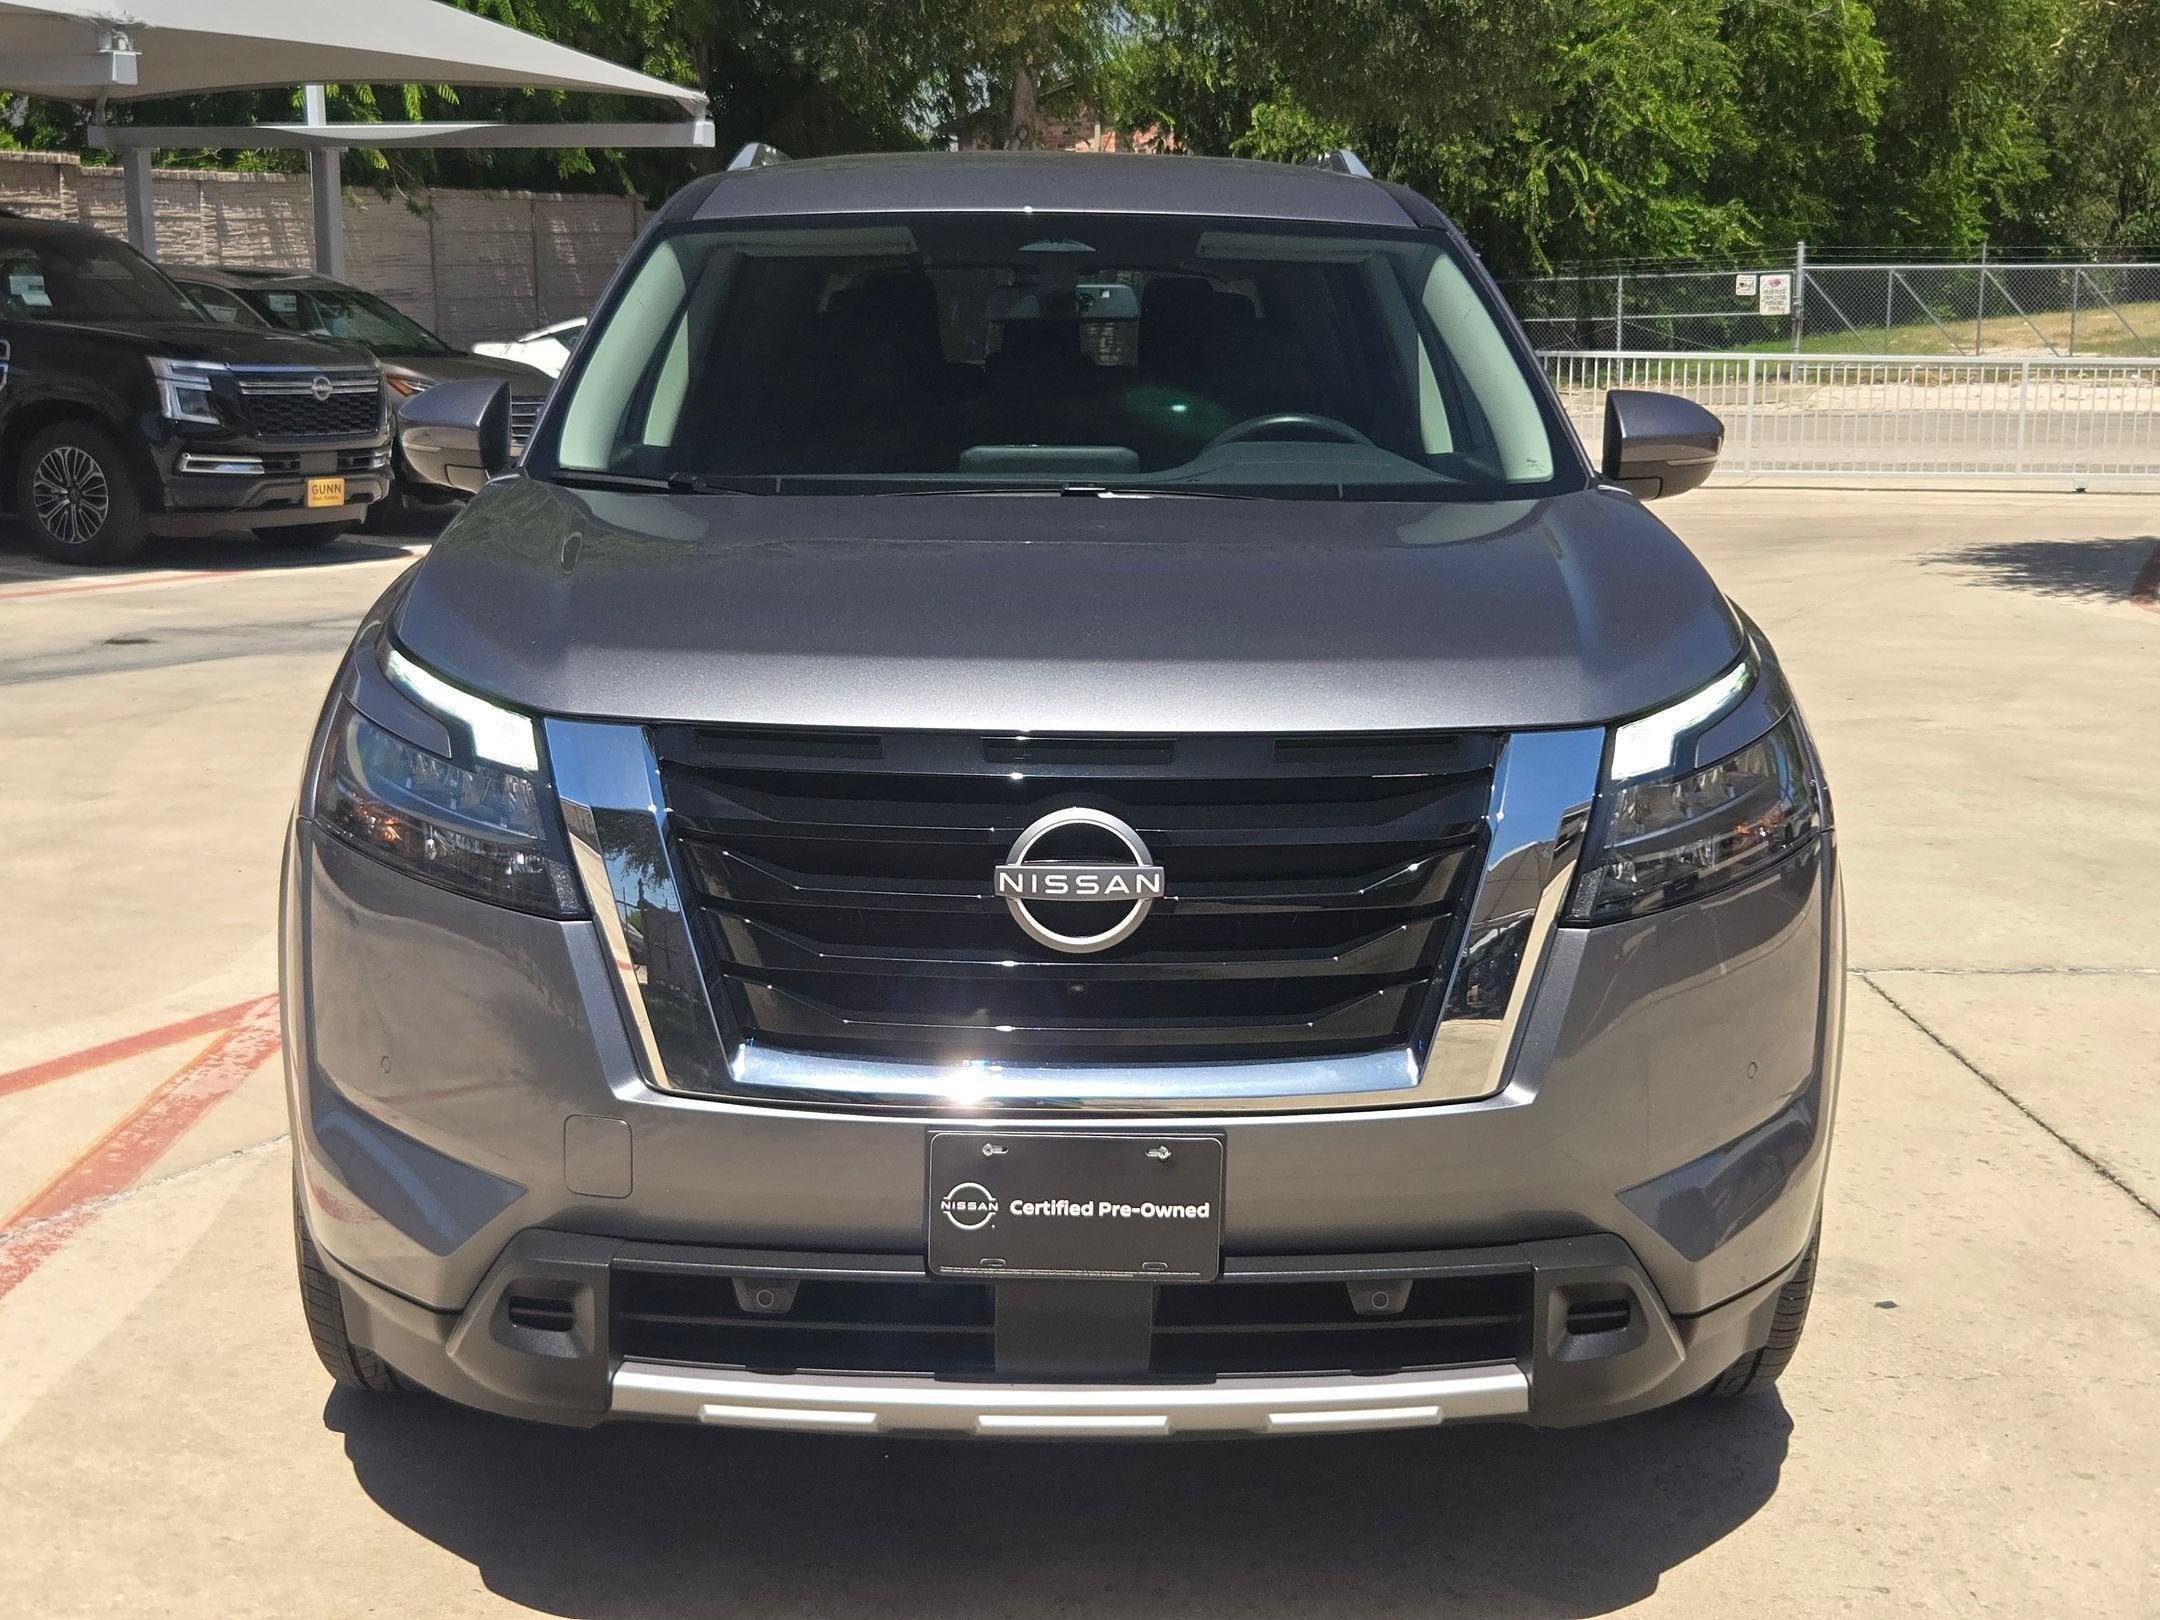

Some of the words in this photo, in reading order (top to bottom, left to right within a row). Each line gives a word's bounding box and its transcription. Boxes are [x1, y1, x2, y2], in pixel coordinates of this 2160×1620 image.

[312, 484, 341, 495] GUNN
[1000, 872, 1160, 894] NISSAN
[941, 1201, 998, 1211] NISSAN
[1010, 1200, 1094, 1216] Certified
[1098, 1202, 1210, 1218] Pre-Owned
